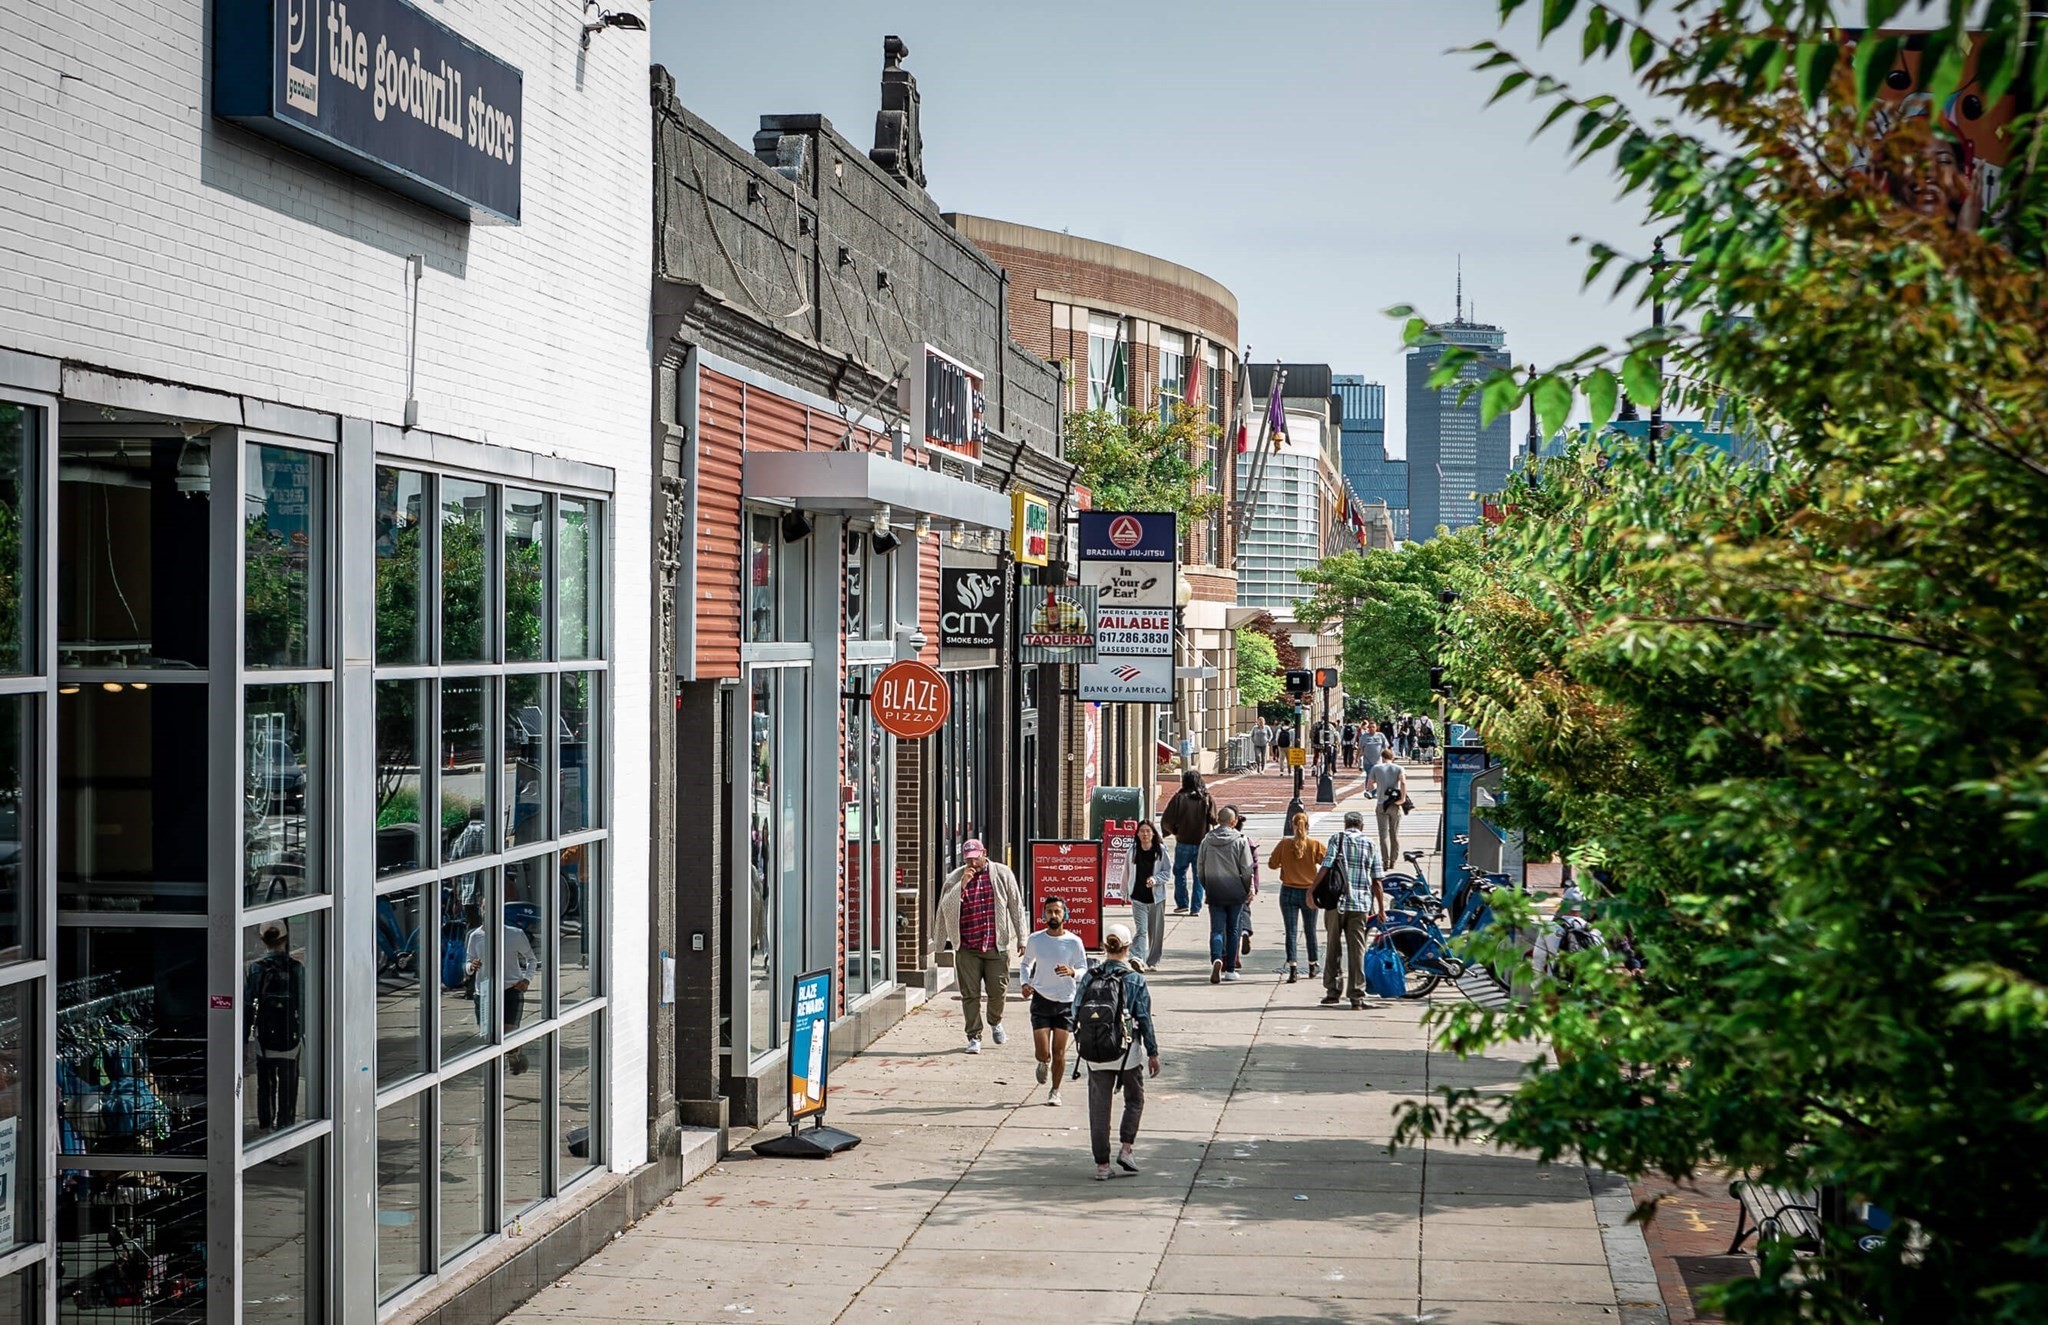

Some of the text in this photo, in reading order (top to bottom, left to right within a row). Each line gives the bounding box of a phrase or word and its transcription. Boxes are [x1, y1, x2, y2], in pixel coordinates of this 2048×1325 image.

[328, 0, 514, 166] the goodwill store
[289, 78, 317, 102] goodwill
[1086, 549, 1126, 557] BRAZILIAN
[1120, 567, 1132, 577] In
[1112, 578, 1140, 587] Your
[1113, 589, 1138, 598] Ear!
[942, 612, 1001, 635] CITY
[946, 636, 994, 645] SMOKE SHOP
[1025, 635, 1093, 645] TAQUERIA
[1099, 632, 1169, 643] 617.286.3830
[882, 678, 938, 712] BLAZE
[885, 711, 934, 723] PIZZA
[799, 983, 818, 1001] BLAZE
[797, 996, 825, 1017] REWARDS
